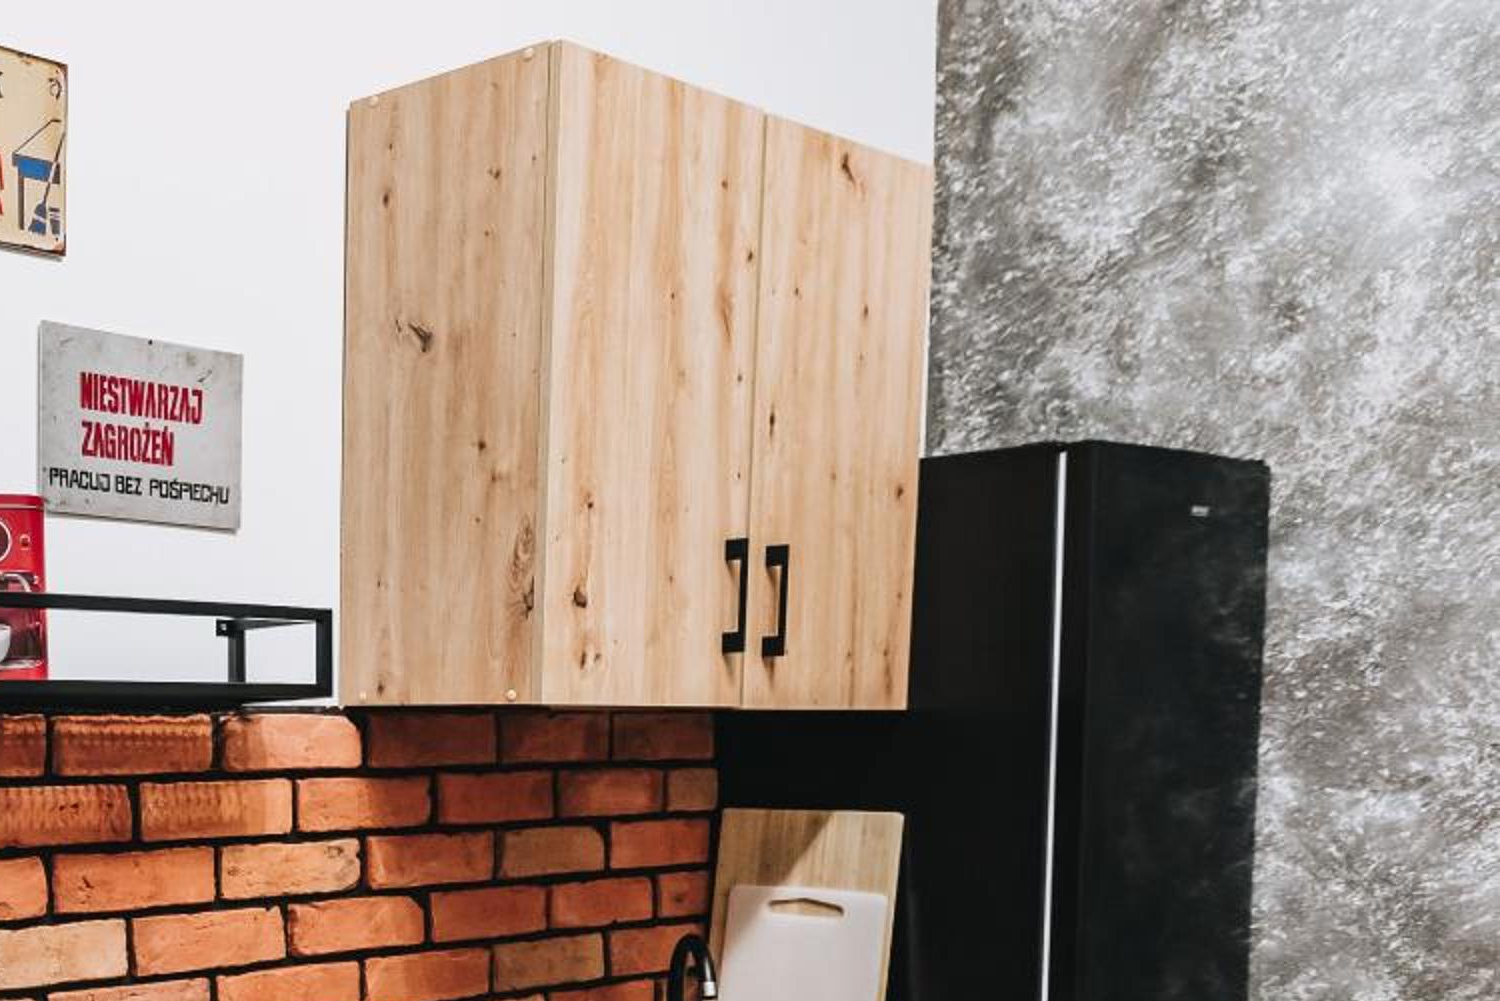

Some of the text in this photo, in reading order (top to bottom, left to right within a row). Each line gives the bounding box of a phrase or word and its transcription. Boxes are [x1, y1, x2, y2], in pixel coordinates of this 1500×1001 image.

[78, 370, 204, 425] NIESTWARZAJ
[81, 420, 175, 467] ZAGROŻEŃ
[49, 467, 231, 505] PRACUJ BEZ POŚPIECHU
